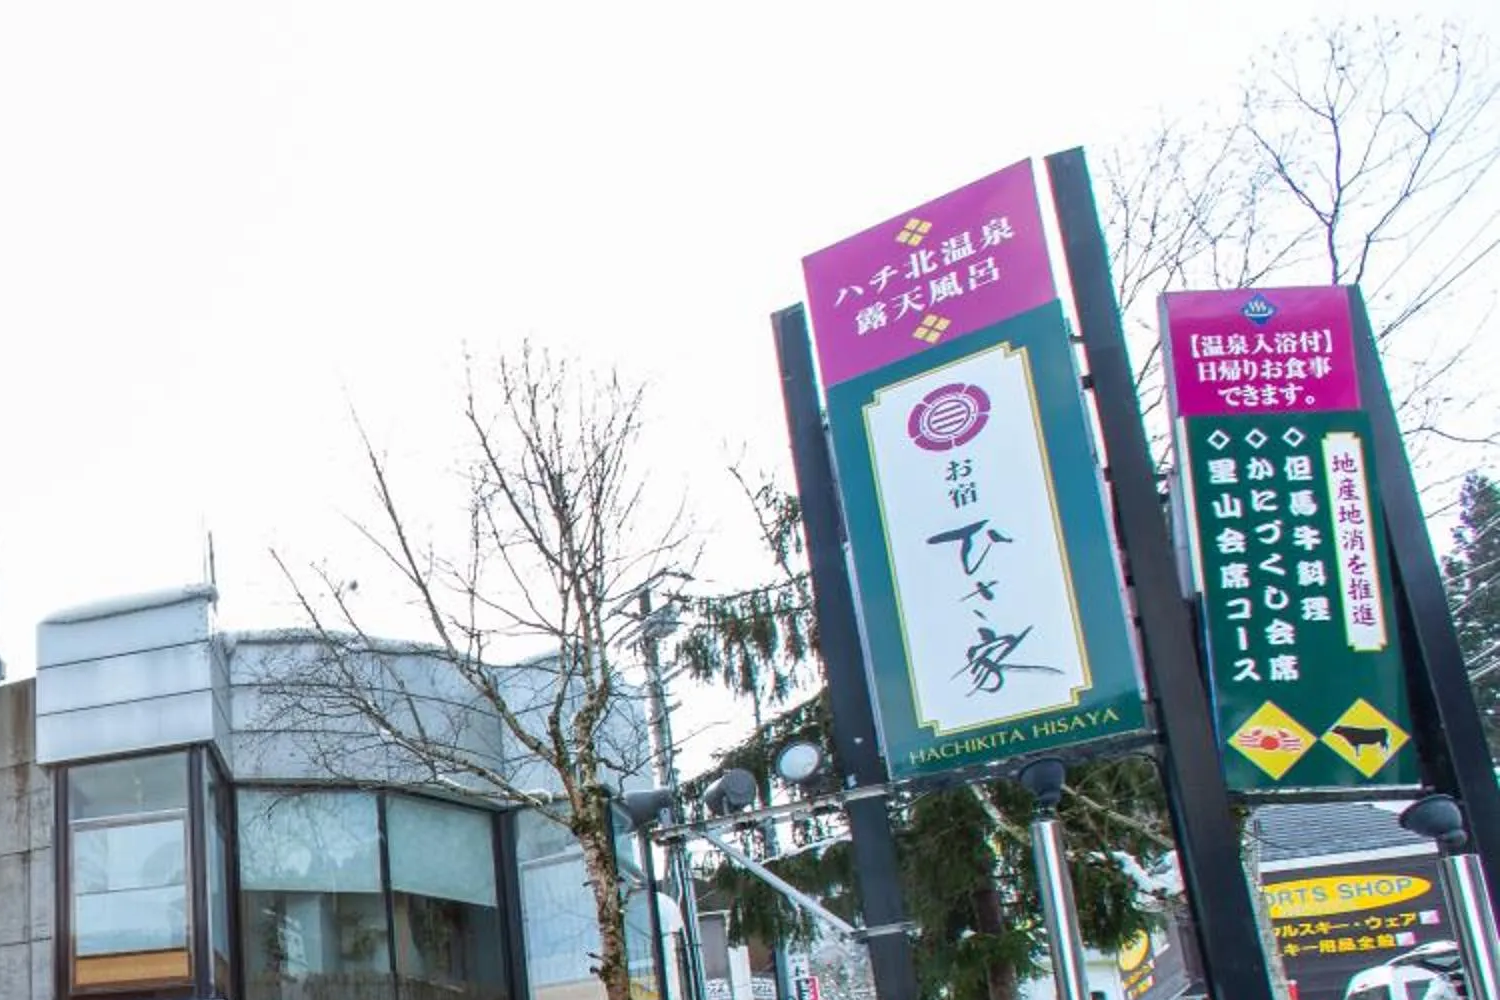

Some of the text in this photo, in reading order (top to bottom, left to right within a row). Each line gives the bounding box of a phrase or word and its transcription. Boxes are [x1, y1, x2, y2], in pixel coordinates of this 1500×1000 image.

[833, 215, 1016, 309] ハチ北温泉
[855, 256, 1001, 336] 露天風呂
[1189, 328, 1334, 359] 【温泉入浴付】
[1197, 355, 1333, 382] 日帰りお食事
[1217, 383, 1316, 408] できます。
[945, 458, 978, 509] お宿
[1283, 455, 1331, 622] 但馬牛料理
[1331, 452, 1378, 628] 地産地消を推進
[1207, 457, 1263, 682] 里山会席コース
[1245, 456, 1300, 682] かにづくし会席
[909, 707, 1120, 766] HACHIKITA HISAYA
[1337, 878, 1413, 901] SHOP
[1280, 933, 1396, 959] キー用品全般
